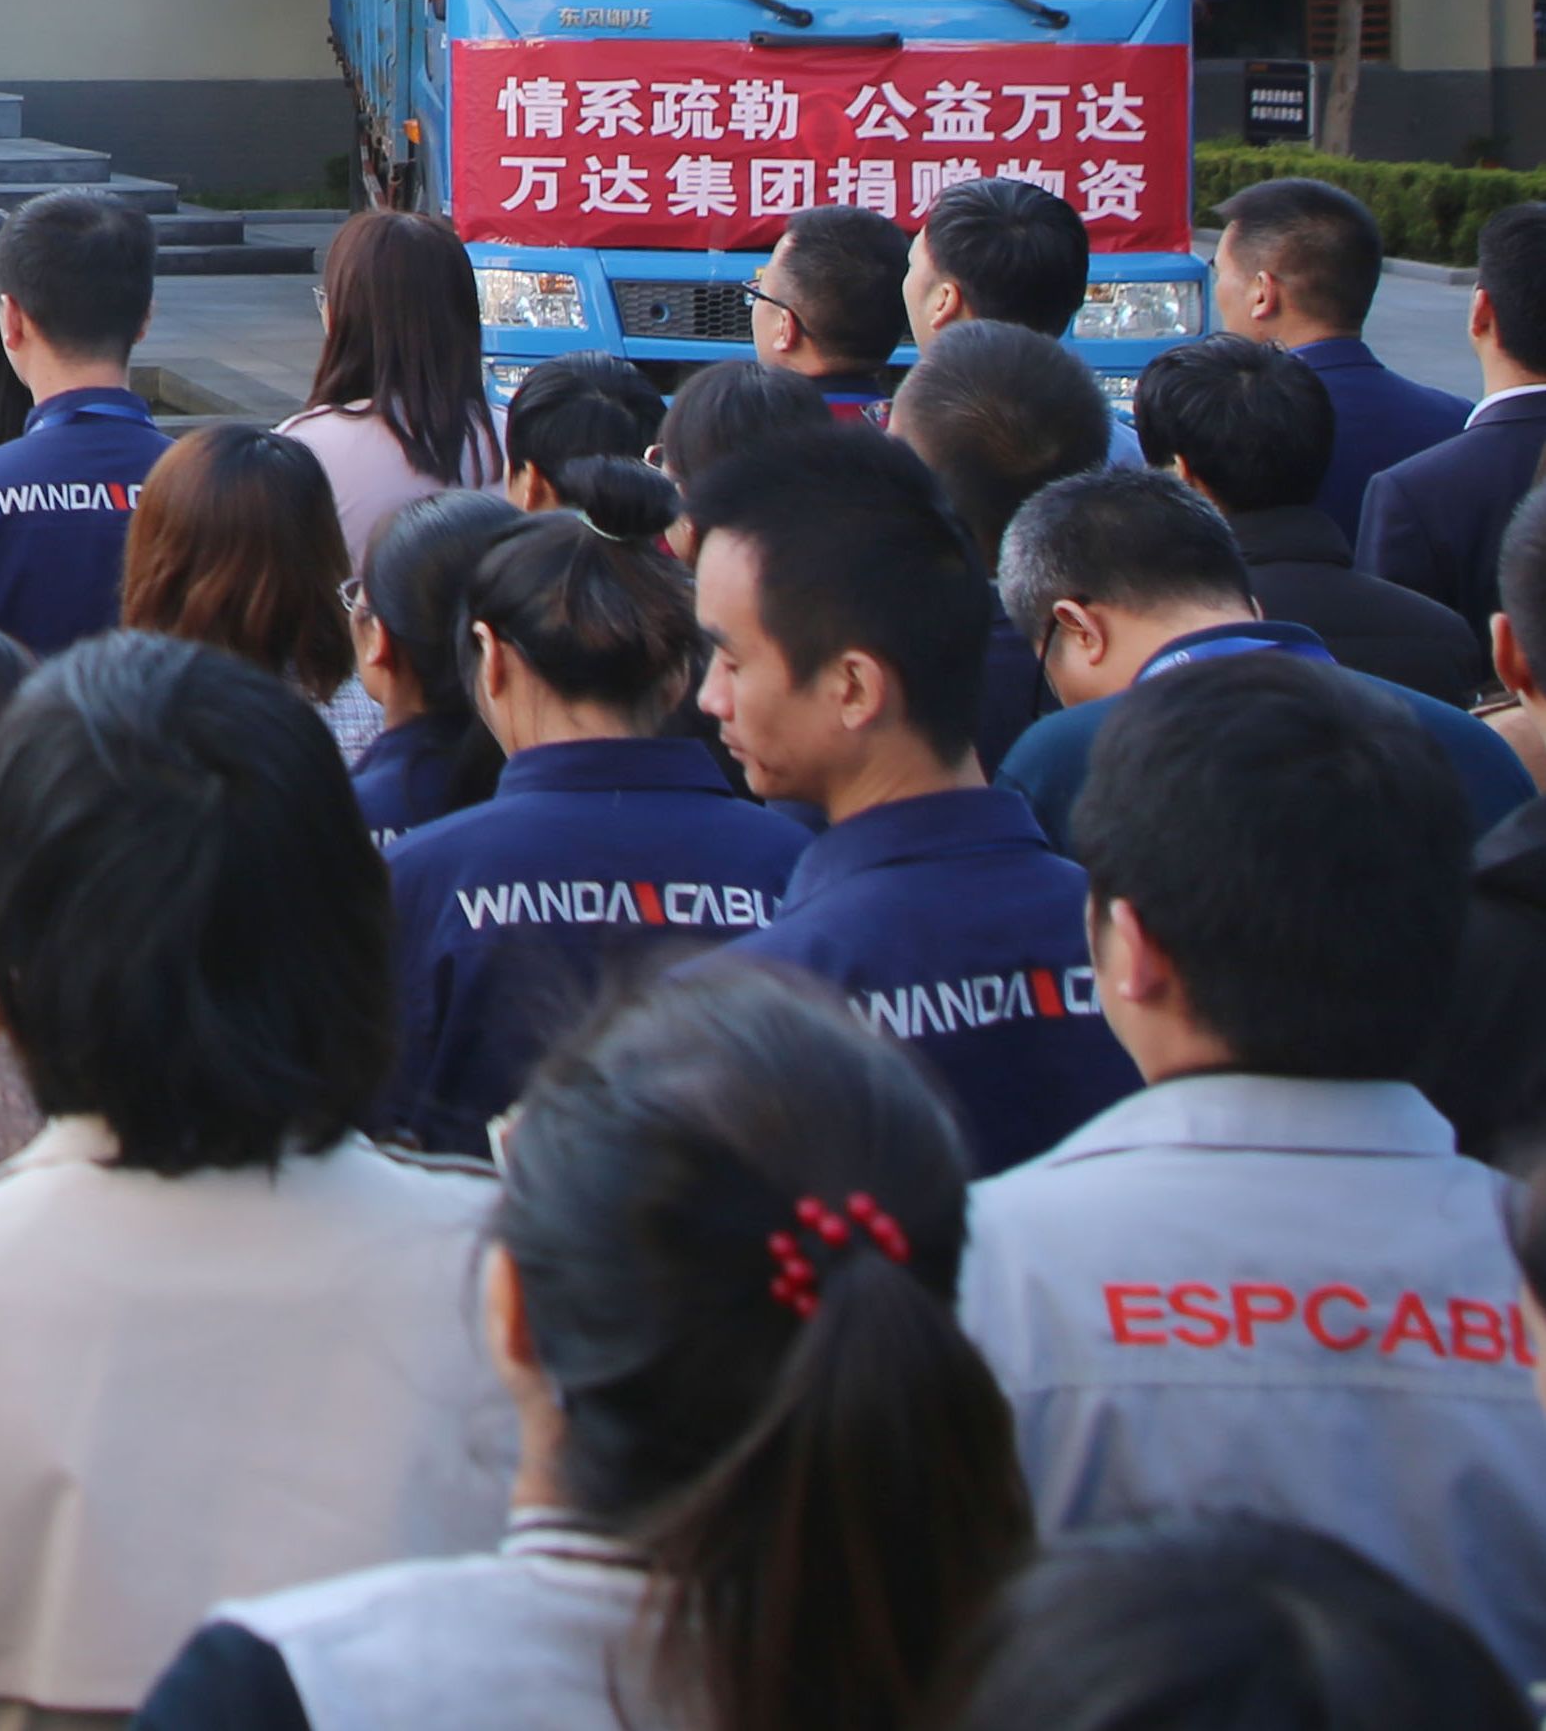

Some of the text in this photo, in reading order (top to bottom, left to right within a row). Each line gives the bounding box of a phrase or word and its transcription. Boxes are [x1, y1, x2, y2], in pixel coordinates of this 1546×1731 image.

[497, 77, 1147, 143] 情系疏勒 公益万达
[456, 881, 783, 930] WANDA CABL
[847, 972, 1035, 1039] WANDA
